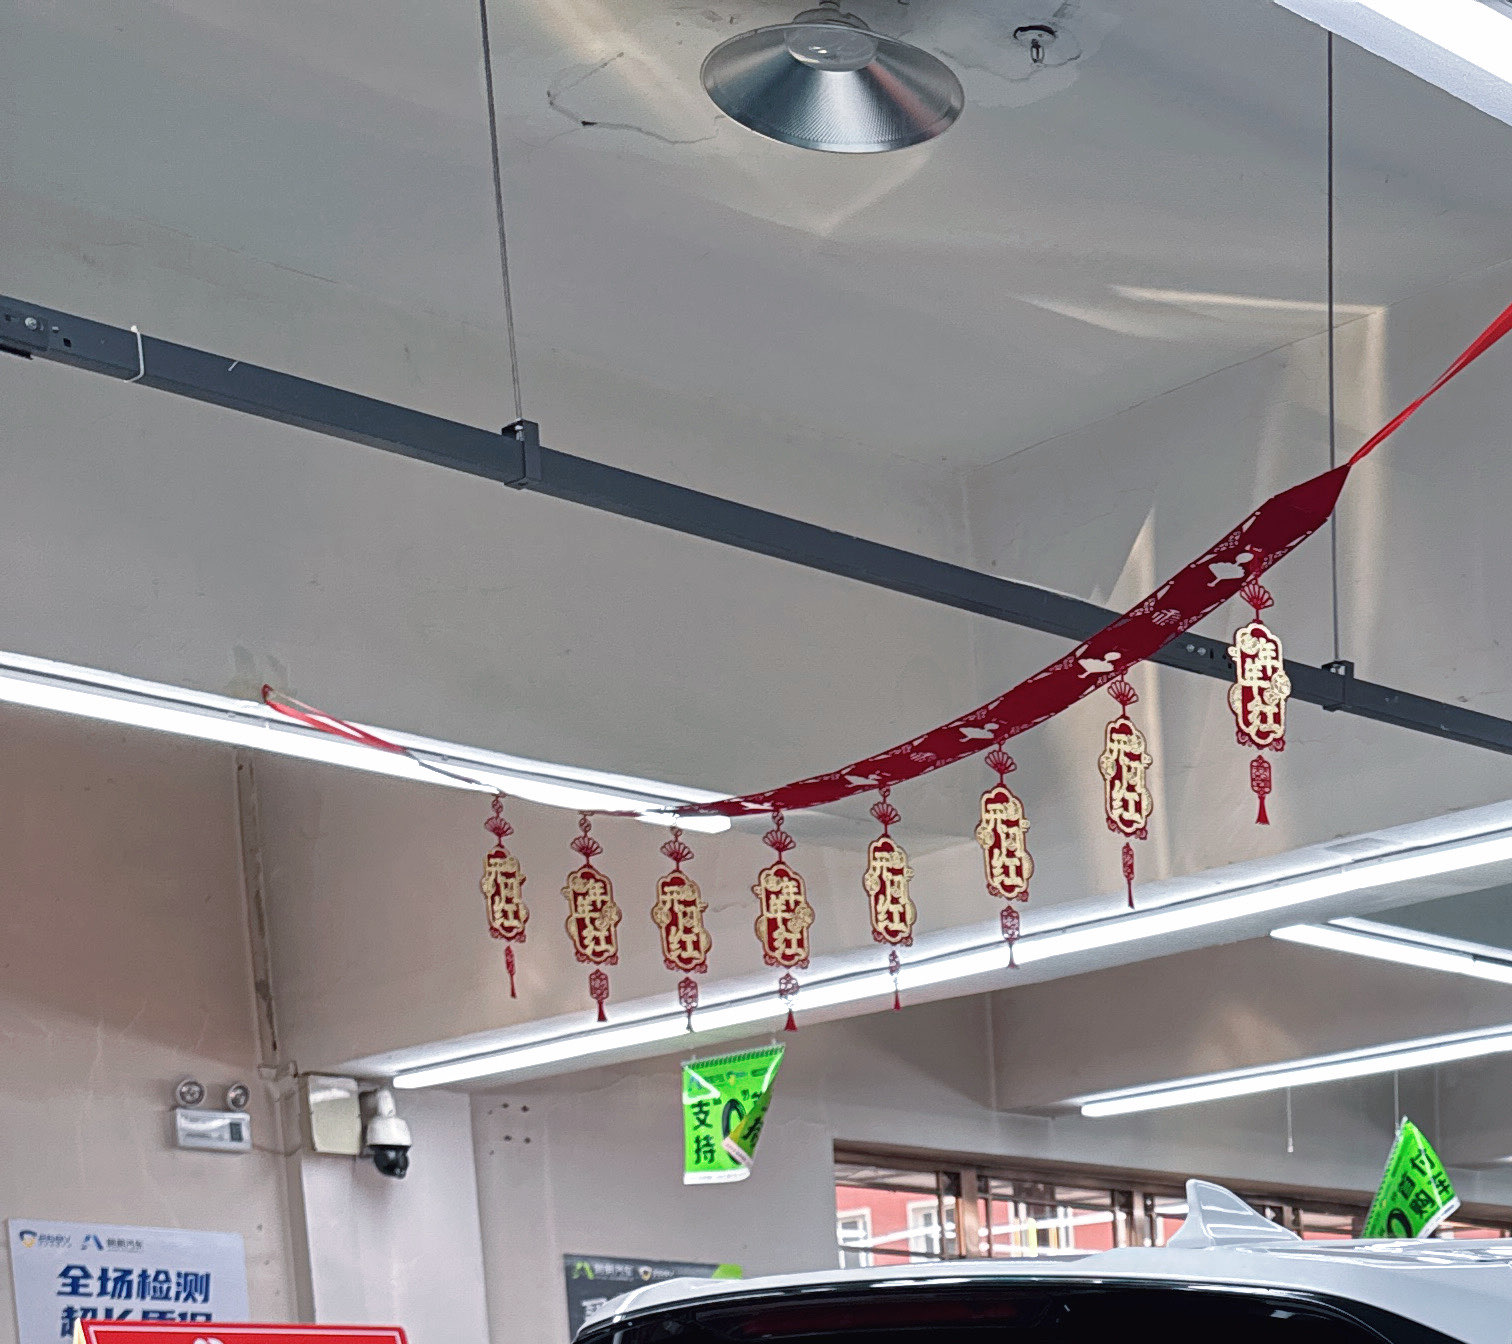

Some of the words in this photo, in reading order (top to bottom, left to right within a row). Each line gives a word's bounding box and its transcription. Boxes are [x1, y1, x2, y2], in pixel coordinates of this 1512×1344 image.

[691, 1101, 715, 1164] 支持
[57, 1264, 211, 1304] 全场检测
